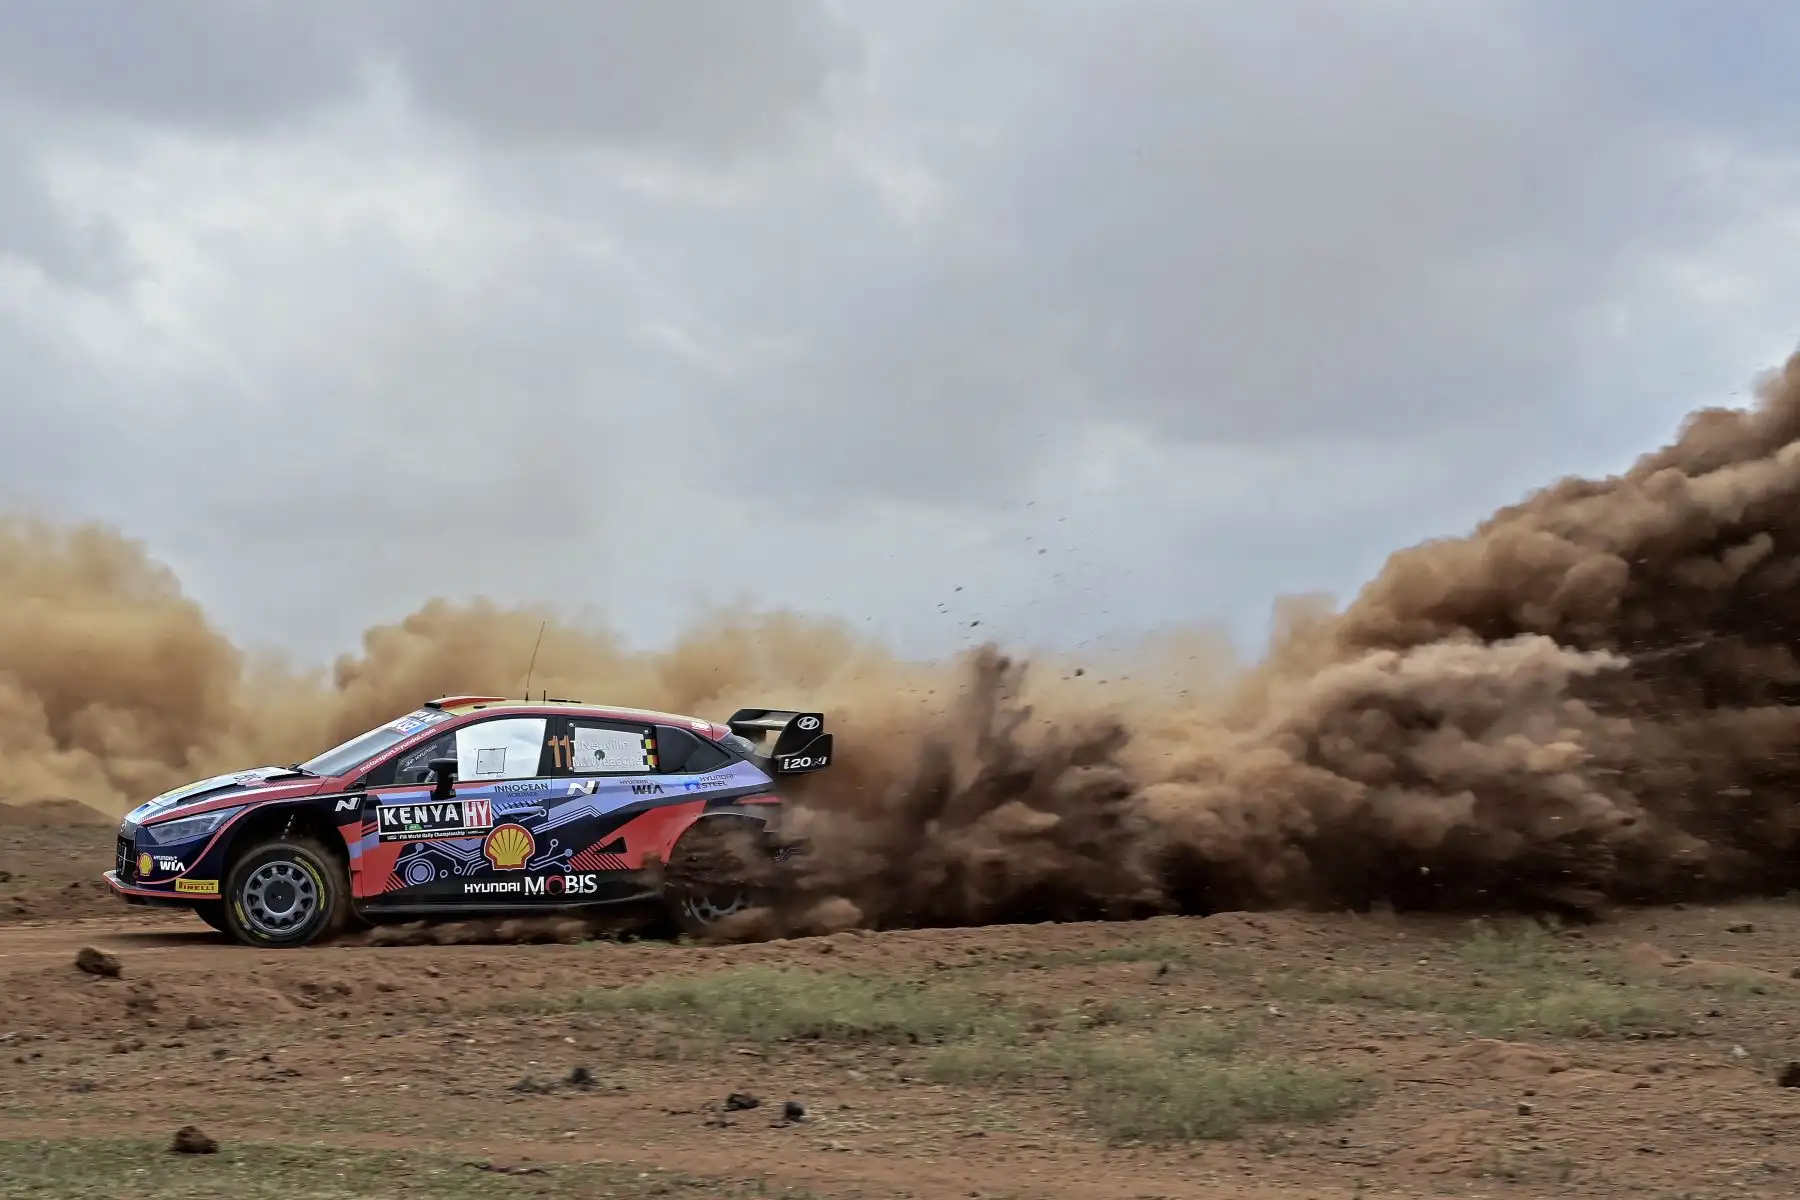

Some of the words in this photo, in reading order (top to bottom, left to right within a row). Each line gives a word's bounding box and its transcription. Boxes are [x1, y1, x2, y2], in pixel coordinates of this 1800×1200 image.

[359, 728, 437, 773] motorsport.hyundai.com
[547, 735, 573, 768] 11
[783, 757, 811, 770] i20
[699, 773, 734, 782] HYUNDAI
[701, 780, 728, 789] STEEL
[494, 783, 549, 793] INNOCEAN
[566, 780, 600, 795] N
[334, 797, 361, 812] N
[383, 803, 460, 826] KENYA
[464, 800, 489, 827] HY
[434, 830, 466, 838] Championship
[178, 881, 215, 890] PIRELLI
[464, 882, 521, 893] HYUNDAI
[524, 874, 598, 895] MOBIS
